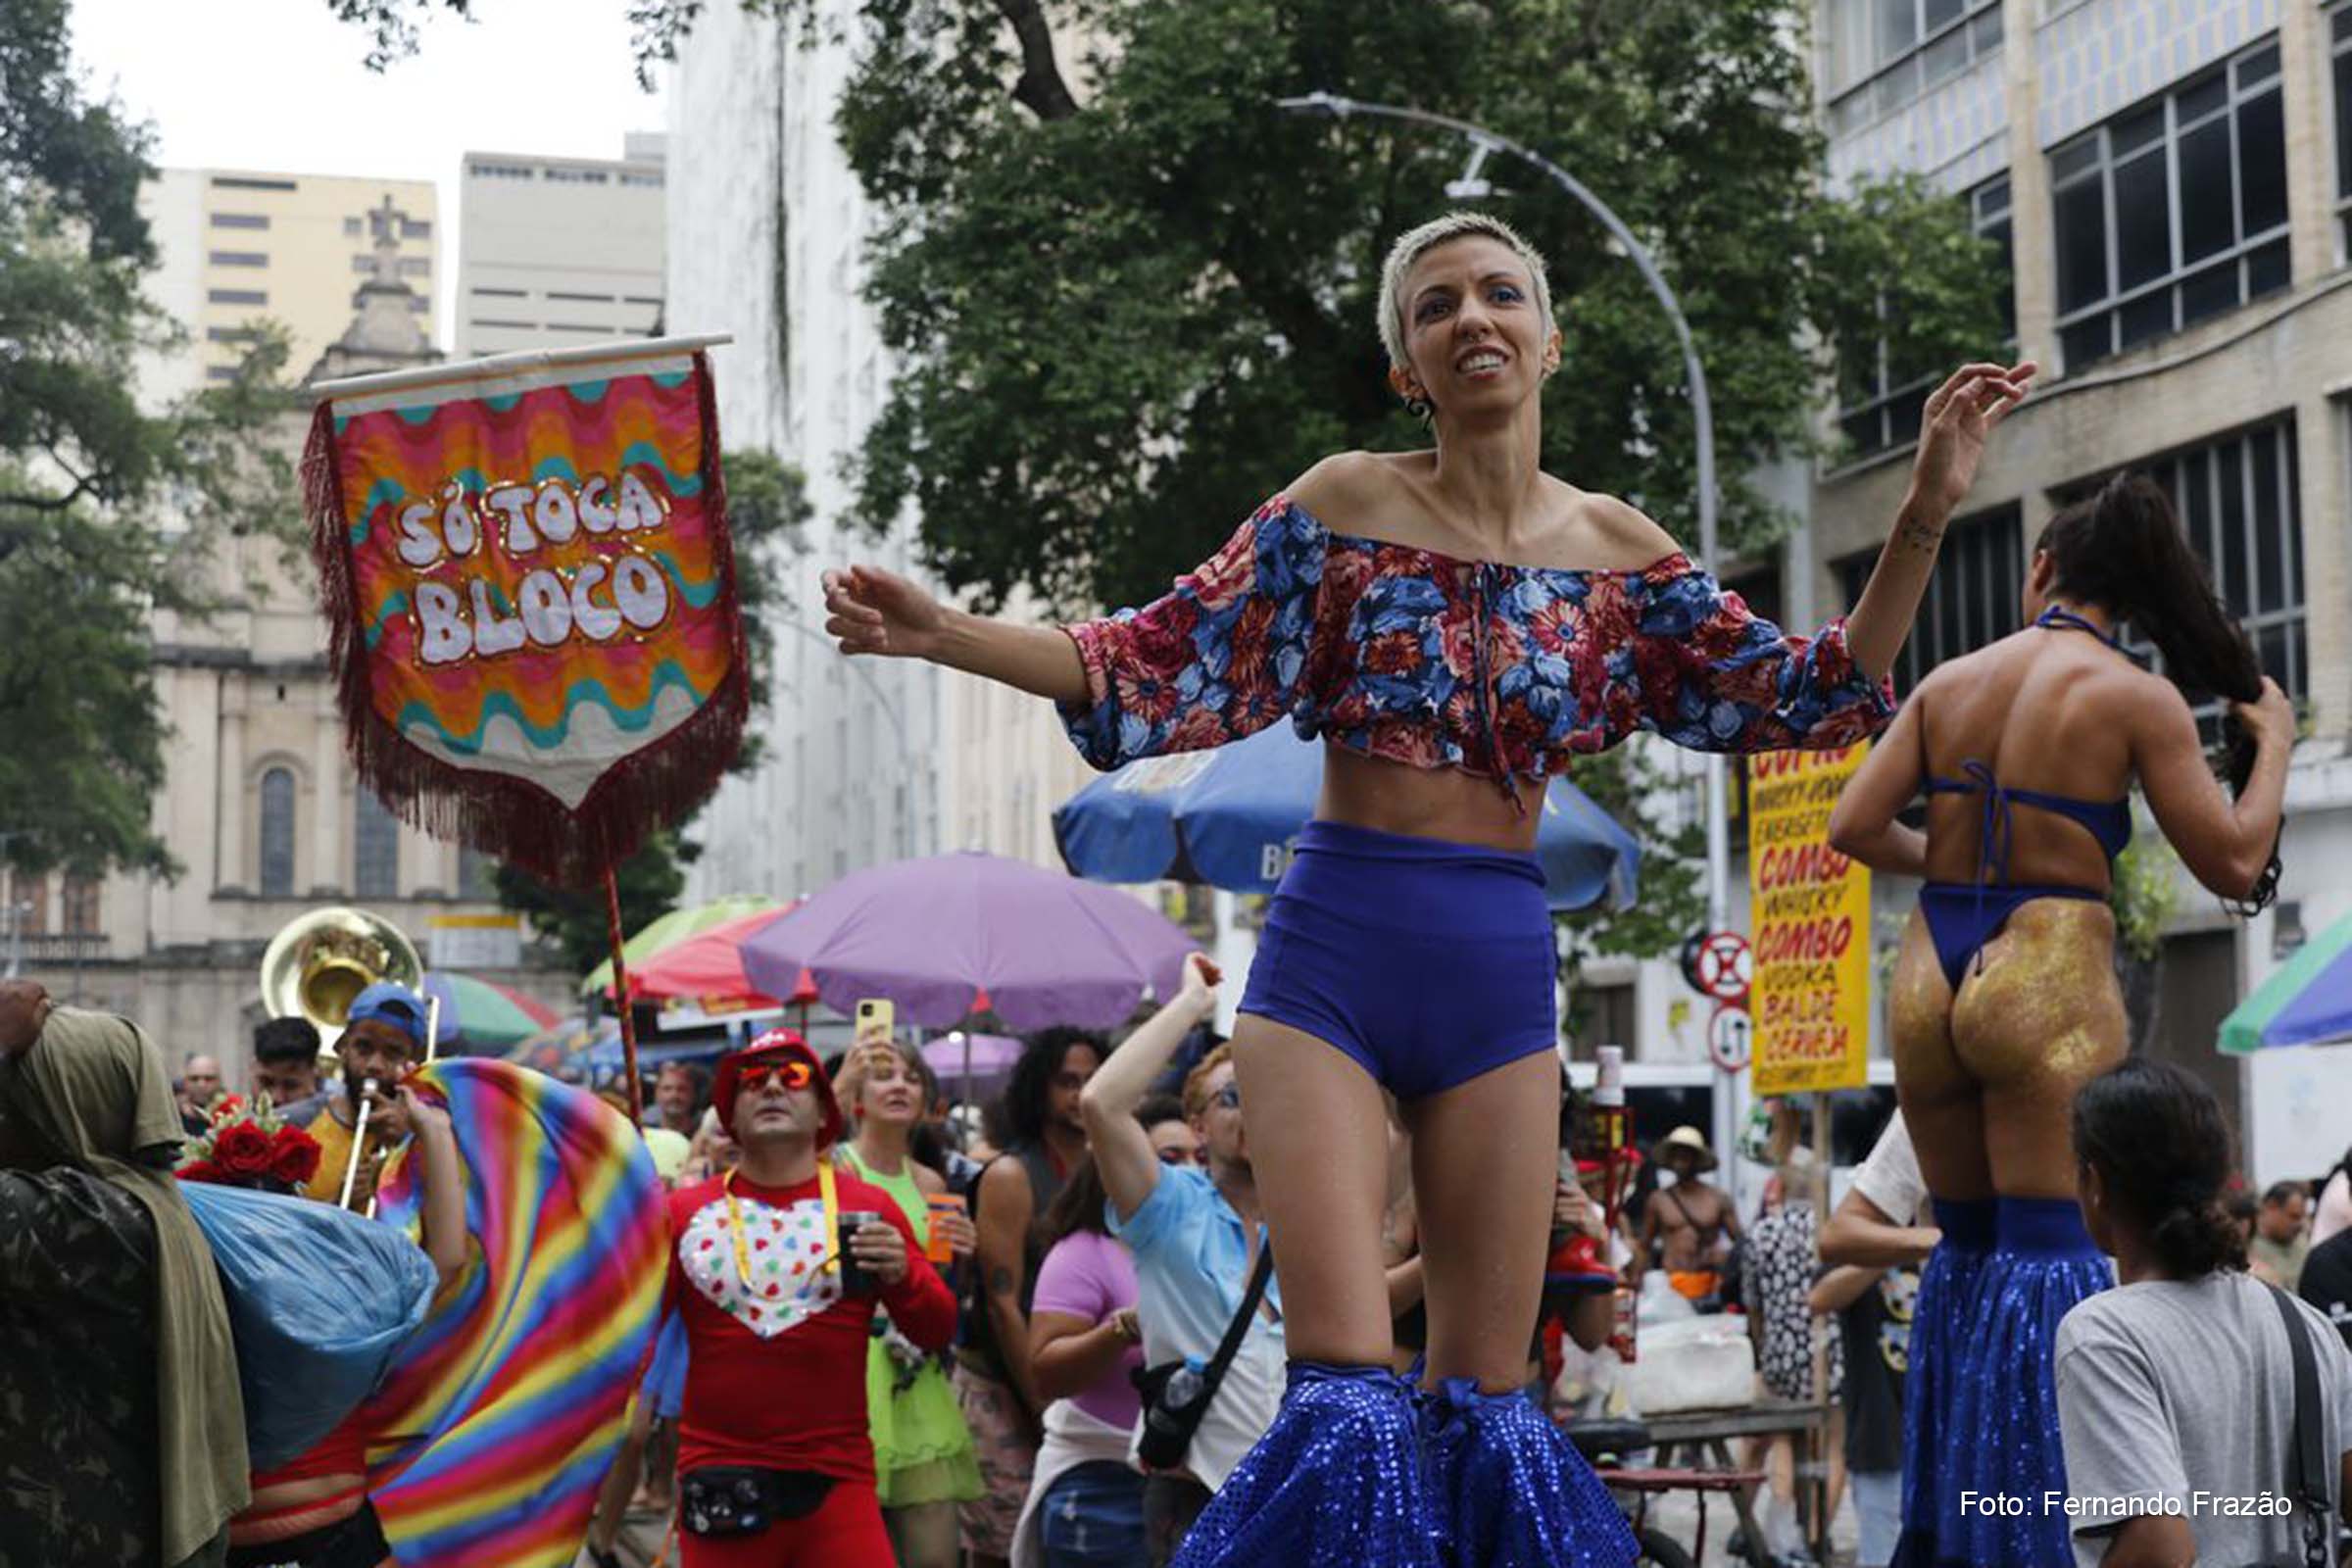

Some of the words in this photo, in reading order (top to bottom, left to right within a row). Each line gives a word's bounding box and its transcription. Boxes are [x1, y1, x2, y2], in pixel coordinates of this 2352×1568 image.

[397, 478, 479, 568] SÓ
[488, 471, 663, 555] TOCA
[414, 554, 670, 665] BLOCO
[1759, 843, 1849, 892] COMBO
[1757, 915, 1851, 967] COMBO
[1764, 961, 1836, 991] VODKA
[1764, 988, 1840, 1026] BALDE
[1766, 1027, 1848, 1062] CERVEJA
